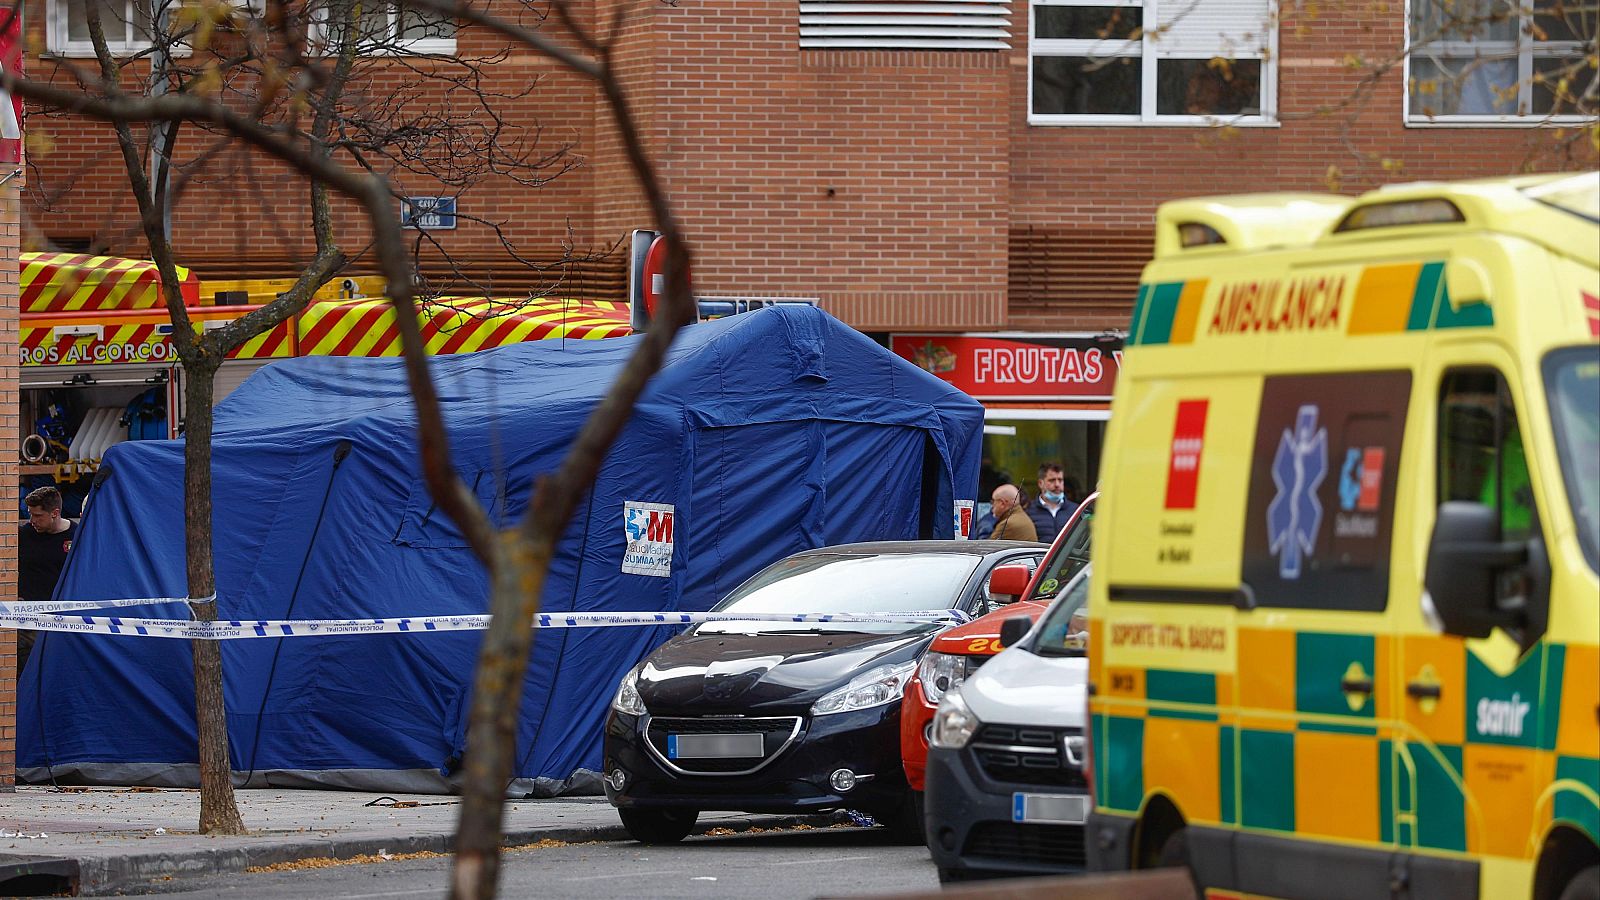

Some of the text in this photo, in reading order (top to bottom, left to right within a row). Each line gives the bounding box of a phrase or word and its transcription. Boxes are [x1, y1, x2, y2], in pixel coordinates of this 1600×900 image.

[1208, 276, 1345, 335] AMBULANCIA
[974, 348, 1103, 383] FRUTAS
[625, 555, 654, 565] SUMMA
[34, 621, 68, 629] MUNICIPAL
[1476, 692, 1530, 737] sanir
